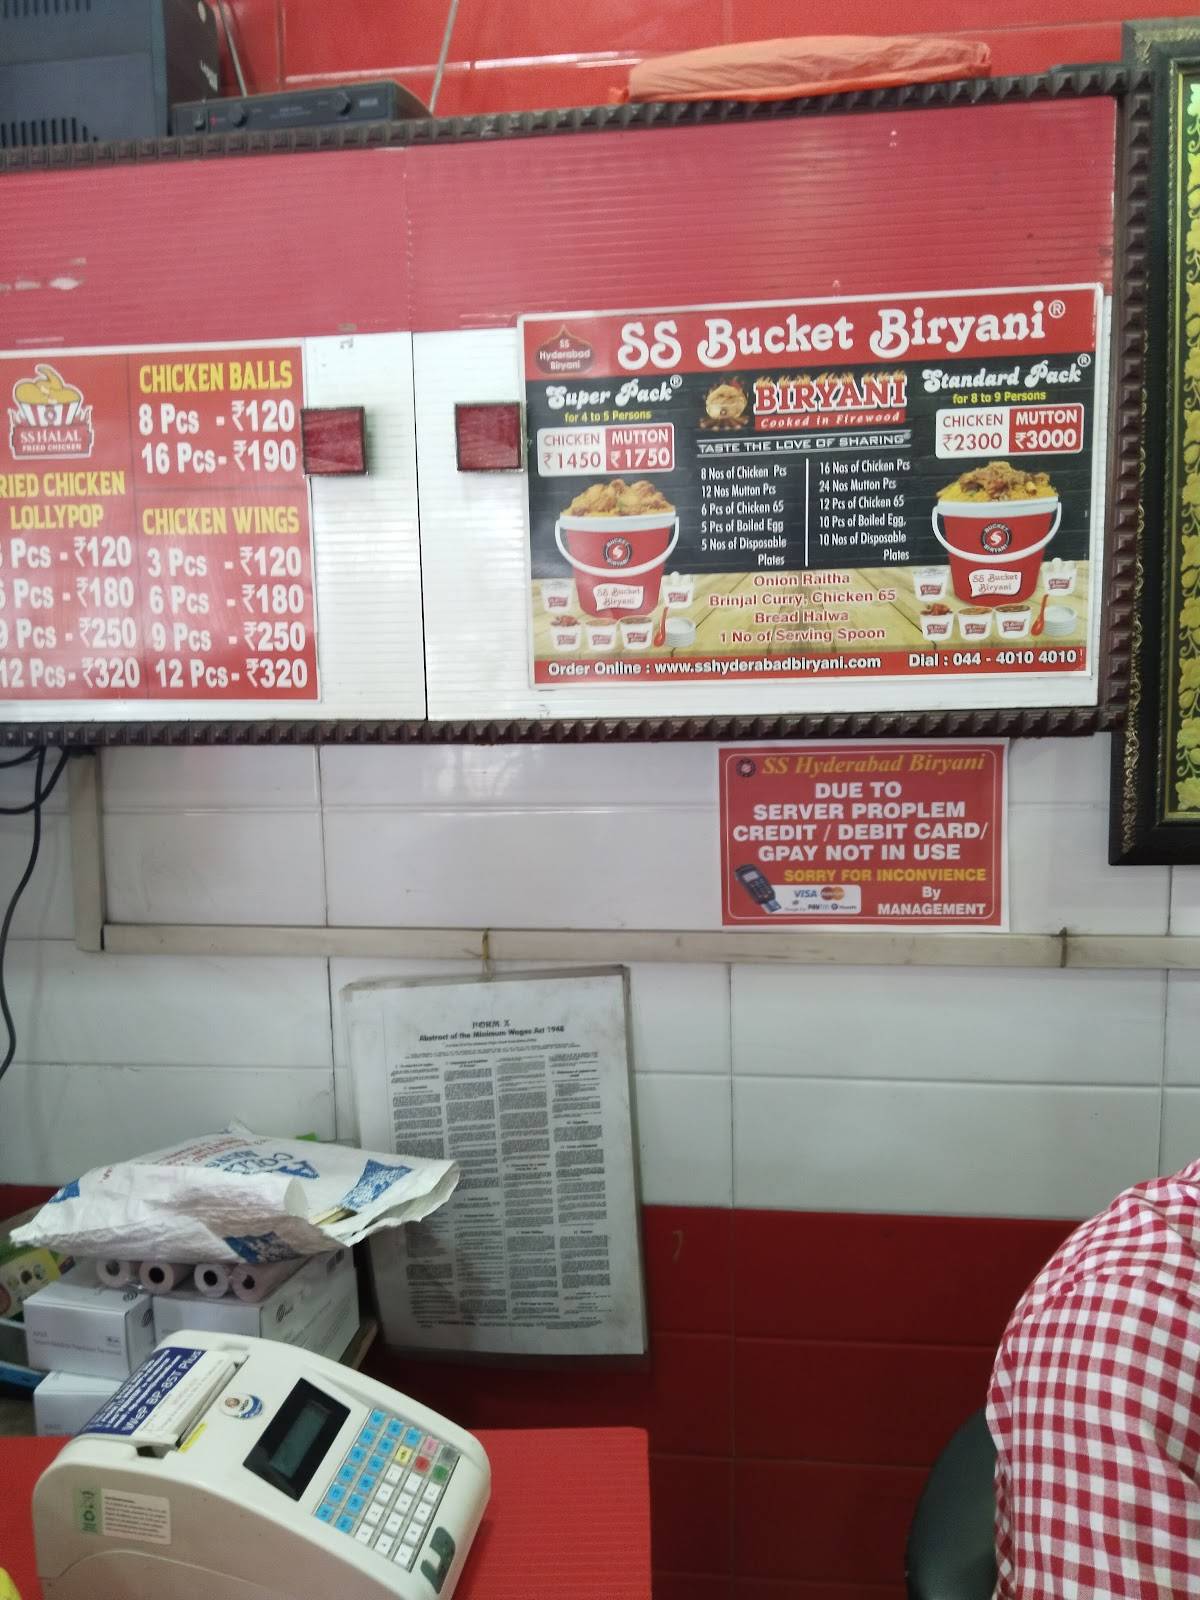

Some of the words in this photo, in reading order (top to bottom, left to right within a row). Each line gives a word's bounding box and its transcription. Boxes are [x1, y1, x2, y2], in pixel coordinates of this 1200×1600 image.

[617, 320, 682, 370] SS
[697, 314, 854, 368] Bucket
[539, 349, 591, 362] Hyderabad
[550, 360, 581, 371] Biryani
[140, 363, 224, 394] CHICKEN
[229, 360, 292, 390] BALLS
[922, 366, 1020, 393] Standard
[546, 386, 610, 410] Super
[754, 375, 907, 414] BIRYANI
[1004, 390, 1046, 402] Persons
[161, 402, 200, 434] Pcs
[613, 410, 651, 421] Persons
[761, 416, 809, 428] Cooked
[817, 415, 828, 425] in
[836, 412, 900, 424] Firewood
[943, 413, 1003, 428] CHICKEN
[1015, 410, 1078, 426] MUTTON
[543, 433, 600, 447] CHICKEN
[612, 428, 669, 444] MUTTON
[699, 443, 740, 454] TASTE
[744, 441, 771, 451] THE
[776, 439, 811, 450] LOVE
[816, 438, 835, 447] OF
[142, 443, 170, 473] 16
[709, 467, 725, 480] Nos
[737, 465, 768, 478] Chicken
[774, 464, 787, 477] Pcs
[820, 462, 830, 475] 16
[833, 461, 848, 474] Nos
[861, 460, 894, 472] Chicken
[897, 459, 910, 471] Pcs
[44, 471, 125, 497] CHICKEN
[701, 486, 711, 498] 12
[714, 484, 729, 497] Nos
[731, 484, 760, 496] Mutton
[763, 483, 776, 495] Pcs
[819, 480, 830, 492] 24
[832, 479, 848, 492] Nos
[850, 479, 880, 491] Mutton
[883, 477, 896, 490] Pcs
[709, 503, 723, 515] Pcs
[737, 501, 770, 513] Chicken
[773, 500, 784, 512] 65
[820, 498, 829, 510] 12
[832, 497, 845, 510] Pcs
[858, 496, 891, 508] Chicken
[893, 495, 904, 507] 65
[10, 504, 104, 530] LOLLYPOP
[143, 508, 228, 535] CHICKEN
[232, 506, 300, 534] WINGS
[820, 516, 829, 528] 10
[832, 515, 845, 528] Pcs
[858, 514, 885, 526] Boiled
[709, 521, 723, 533] Pcs
[737, 519, 764, 531] Boiled
[767, 519, 784, 532] Egg
[709, 539, 726, 550] Nos
[739, 535, 787, 551] Disposable
[820, 534, 829, 546] 10
[832, 534, 847, 545] Nos
[860, 531, 906, 546] Disposable
[11, 538, 51, 569] Pcs
[168, 547, 207, 577] Pcs
[758, 554, 784, 566] Plates
[883, 548, 910, 561] Plates
[753, 575, 798, 587] Onion
[802, 572, 850, 586] Raitha
[13, 579, 54, 609] Pcs
[171, 585, 209, 613] Pcs
[709, 594, 757, 608] Brinjal
[812, 590, 876, 604] Chicken
[878, 589, 896, 601] 65
[754, 612, 800, 624] Bread
[802, 610, 849, 622] Halwa
[16, 619, 57, 650] Pcs
[174, 622, 212, 651] Pcs
[732, 630, 752, 644] No
[776, 628, 834, 643] Serving
[837, 628, 886, 642] Spoon
[548, 661, 590, 676] Order
[594, 660, 642, 675] Online
[654, 654, 882, 674] www.sshyderabadbiryani.com
[909, 653, 939, 668] Dial
[952, 652, 982, 666] 044
[996, 651, 1033, 665] 4010
[1038, 650, 1076, 664] 4010
[155, 659, 183, 688] 12
[763, 756, 789, 774] SS
[796, 754, 902, 778] Hyderabad
[909, 753, 985, 775] Biryani
[815, 782, 863, 799] DUE
[870, 781, 902, 798] TO
[754, 804, 844, 820] SERVER
[852, 802, 965, 819] PROPLEM
[733, 825, 817, 842] CREDIT
[838, 823, 907, 840] DEBIT
[758, 846, 818, 861] GPAY
[826, 845, 877, 861] NOT
[881, 844, 905, 860] IN
[914, 844, 960, 860] USE
[784, 869, 837, 882] SORRY
[841, 869, 871, 881] FOR
[877, 868, 986, 881] INCONVIENCE
[794, 890, 817, 898] VISA
[922, 886, 941, 900] By
[878, 903, 986, 915] MANAGEMENT
[450, 1032, 457, 1040] of
[473, 1030, 506, 1038] Minimum
[509, 1028, 532, 1037] Wages
